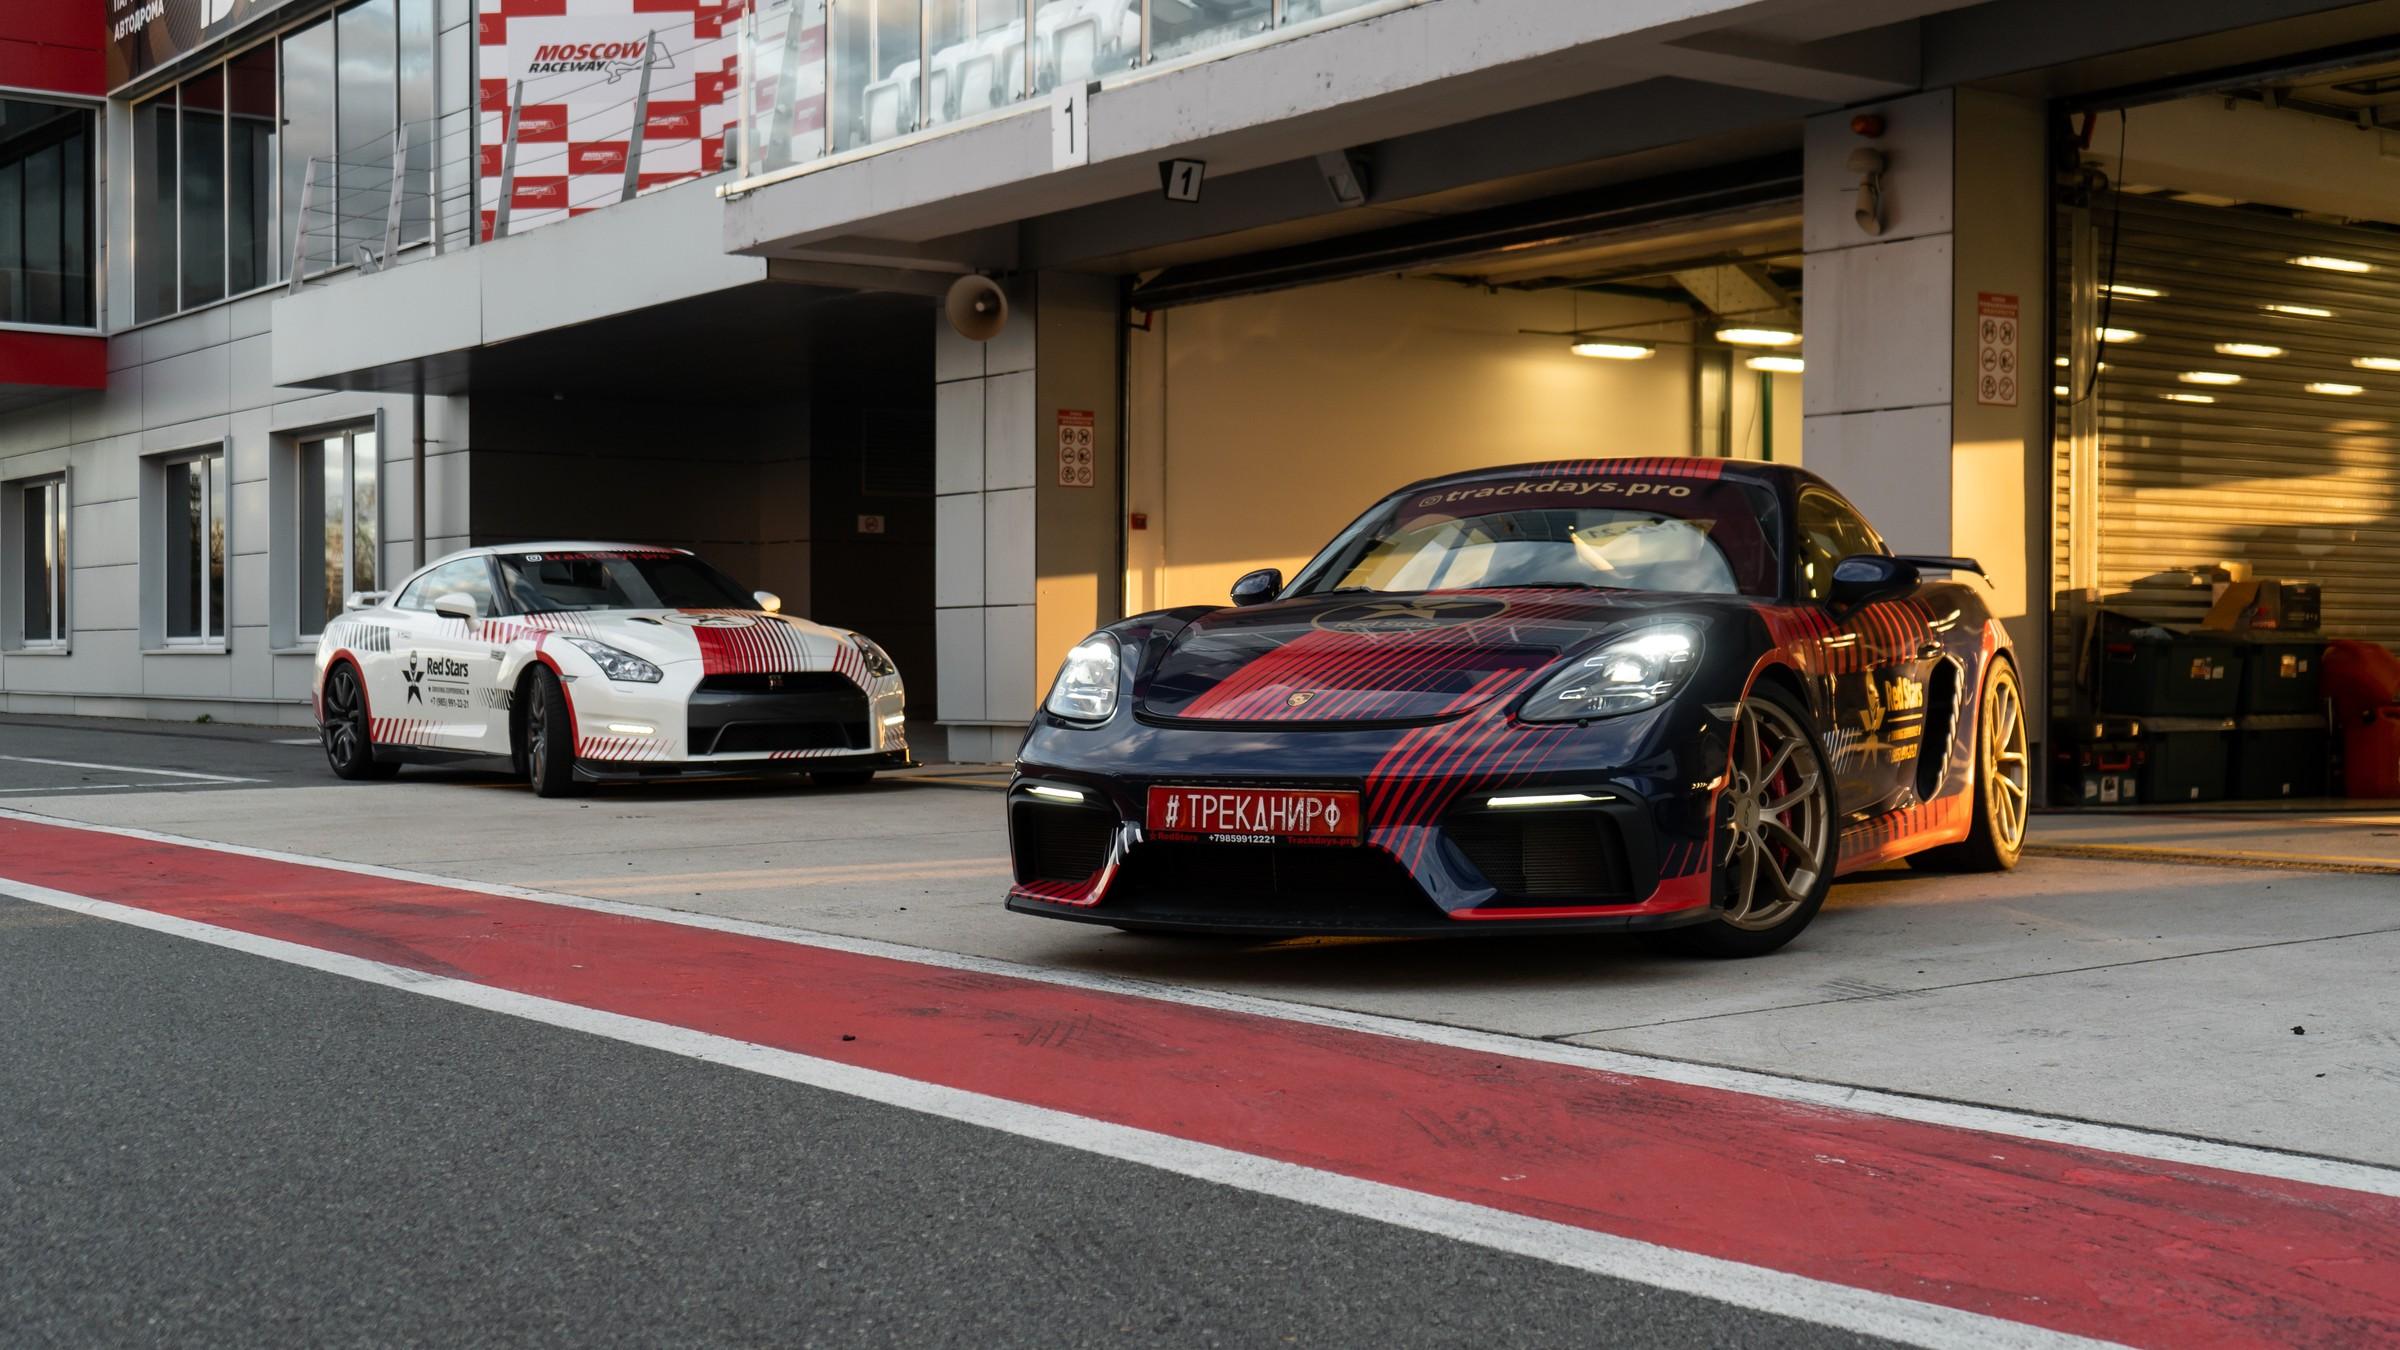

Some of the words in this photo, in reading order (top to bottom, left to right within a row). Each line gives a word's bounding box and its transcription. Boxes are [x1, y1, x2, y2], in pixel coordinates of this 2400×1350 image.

[114, 0, 164, 42] АВТОДРОМА
[534, 41, 646, 61] MOSCOW
[528, 61, 606, 73] RACEWAY
[1064, 97, 1074, 154] 1
[1181, 166, 1192, 196] 1
[1446, 480, 1691, 502] trackdays.pro
[427, 657, 444, 675] Red
[445, 658, 469, 677] Stars
[1209, 834, 1276, 844] +79859912221
